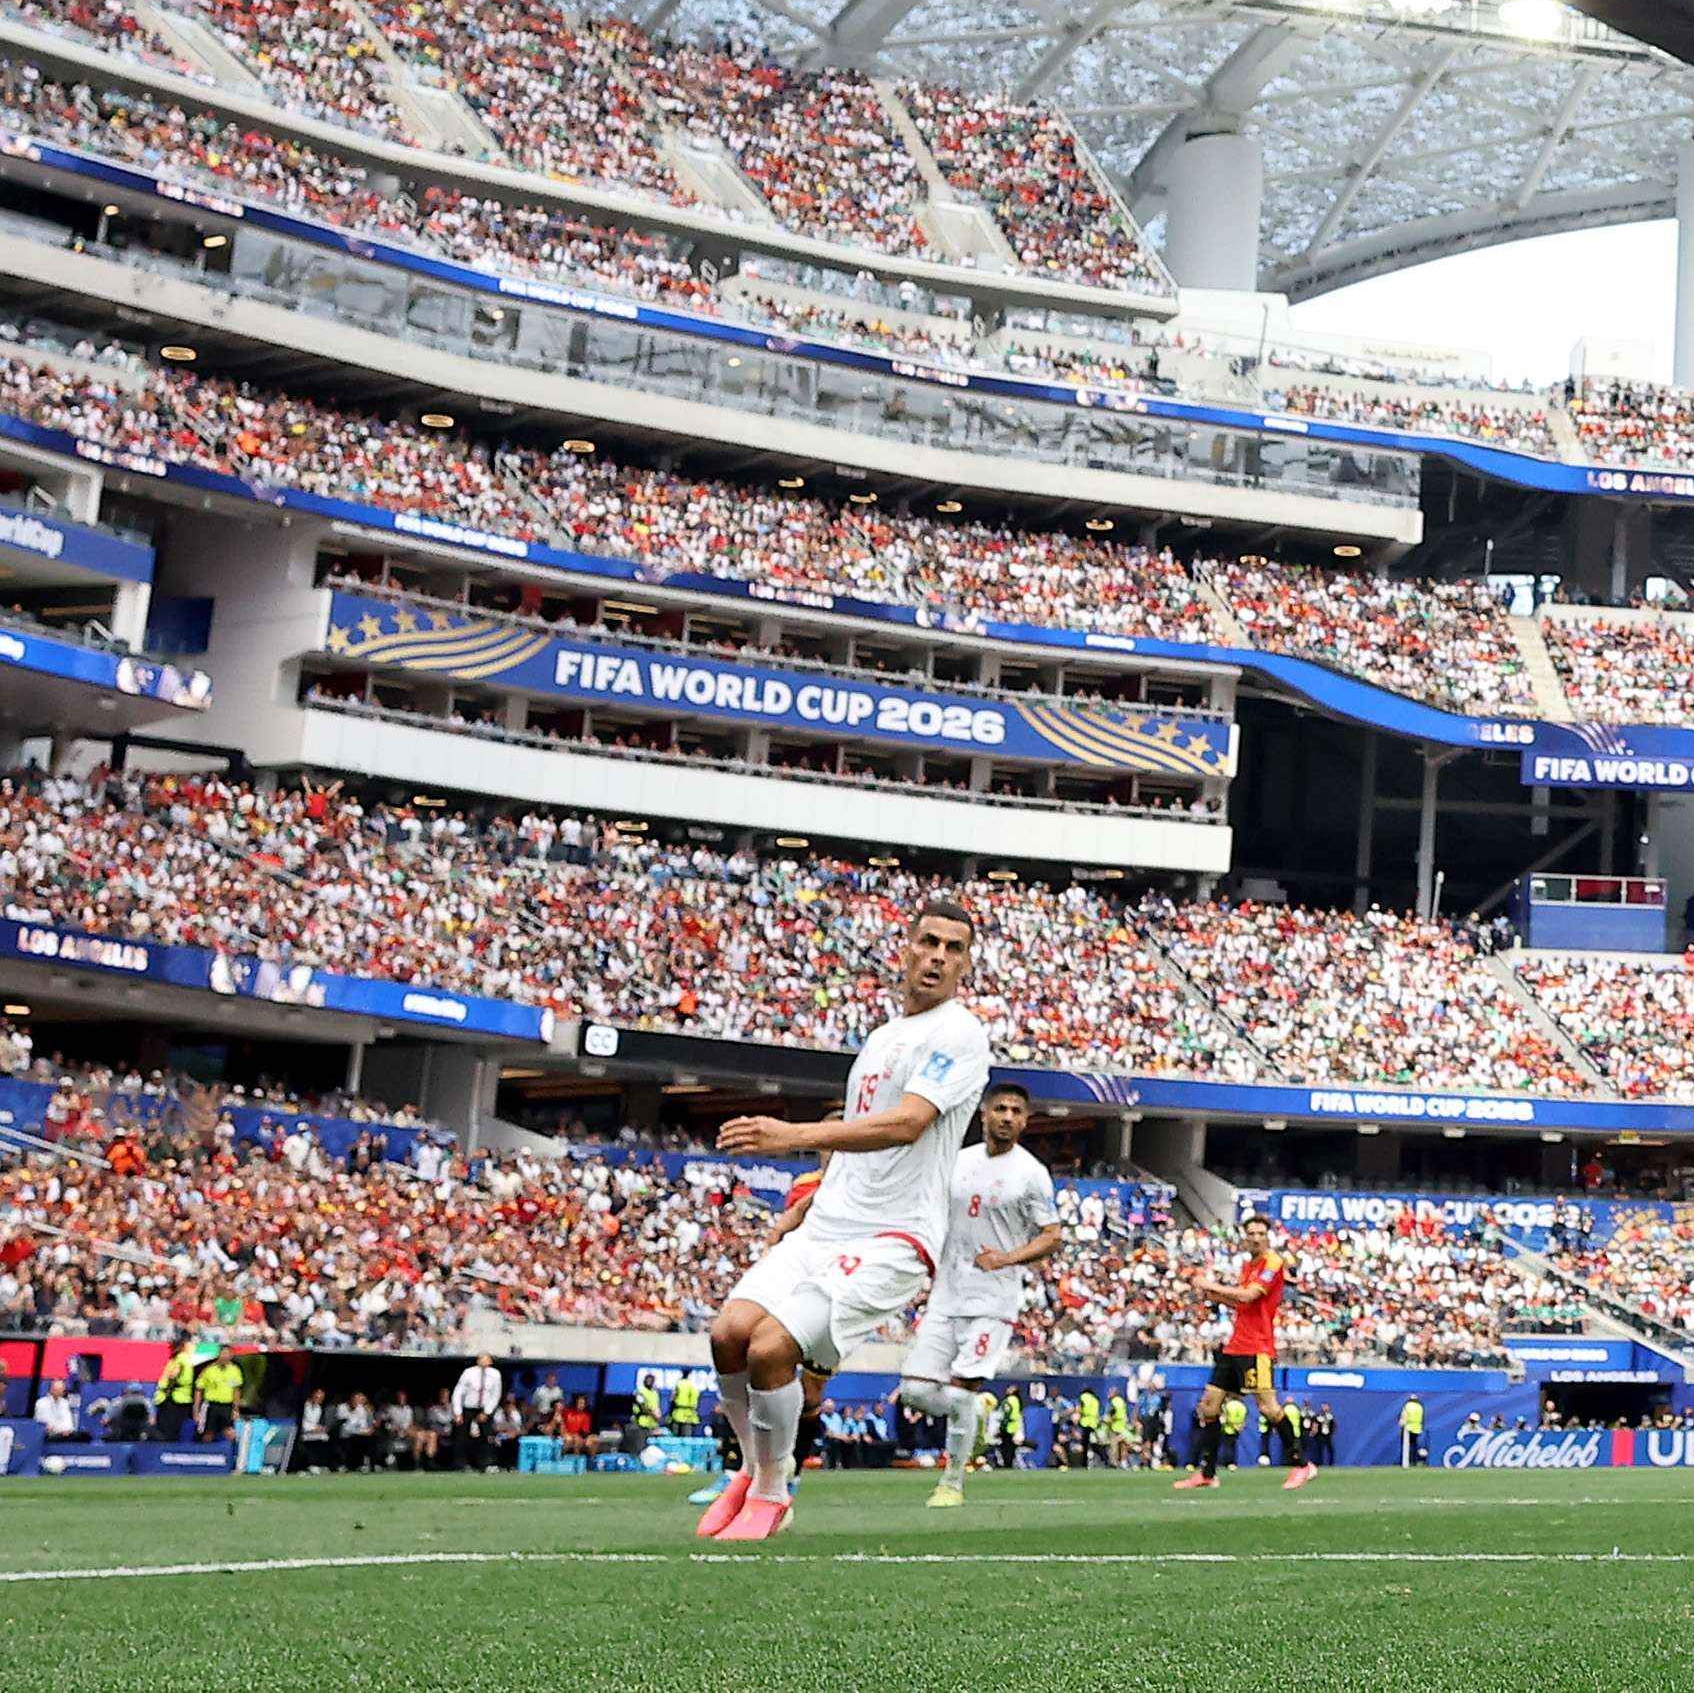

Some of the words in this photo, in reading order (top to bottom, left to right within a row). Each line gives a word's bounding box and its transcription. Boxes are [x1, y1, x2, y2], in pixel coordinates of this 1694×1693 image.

[555, 650, 644, 696] FIFA
[650, 663, 793, 715] WORLD
[796, 685, 875, 727] CUP
[877, 697, 1006, 745] 2026
[1534, 756, 1592, 782] FIFA
[1594, 759, 1689, 786] WORLD
[968, 1195, 980, 1217] 8
[1281, 1194, 1340, 1222] FIFA
[976, 1333, 990, 1356] 8
[1443, 1424, 1604, 1468] Michelob
